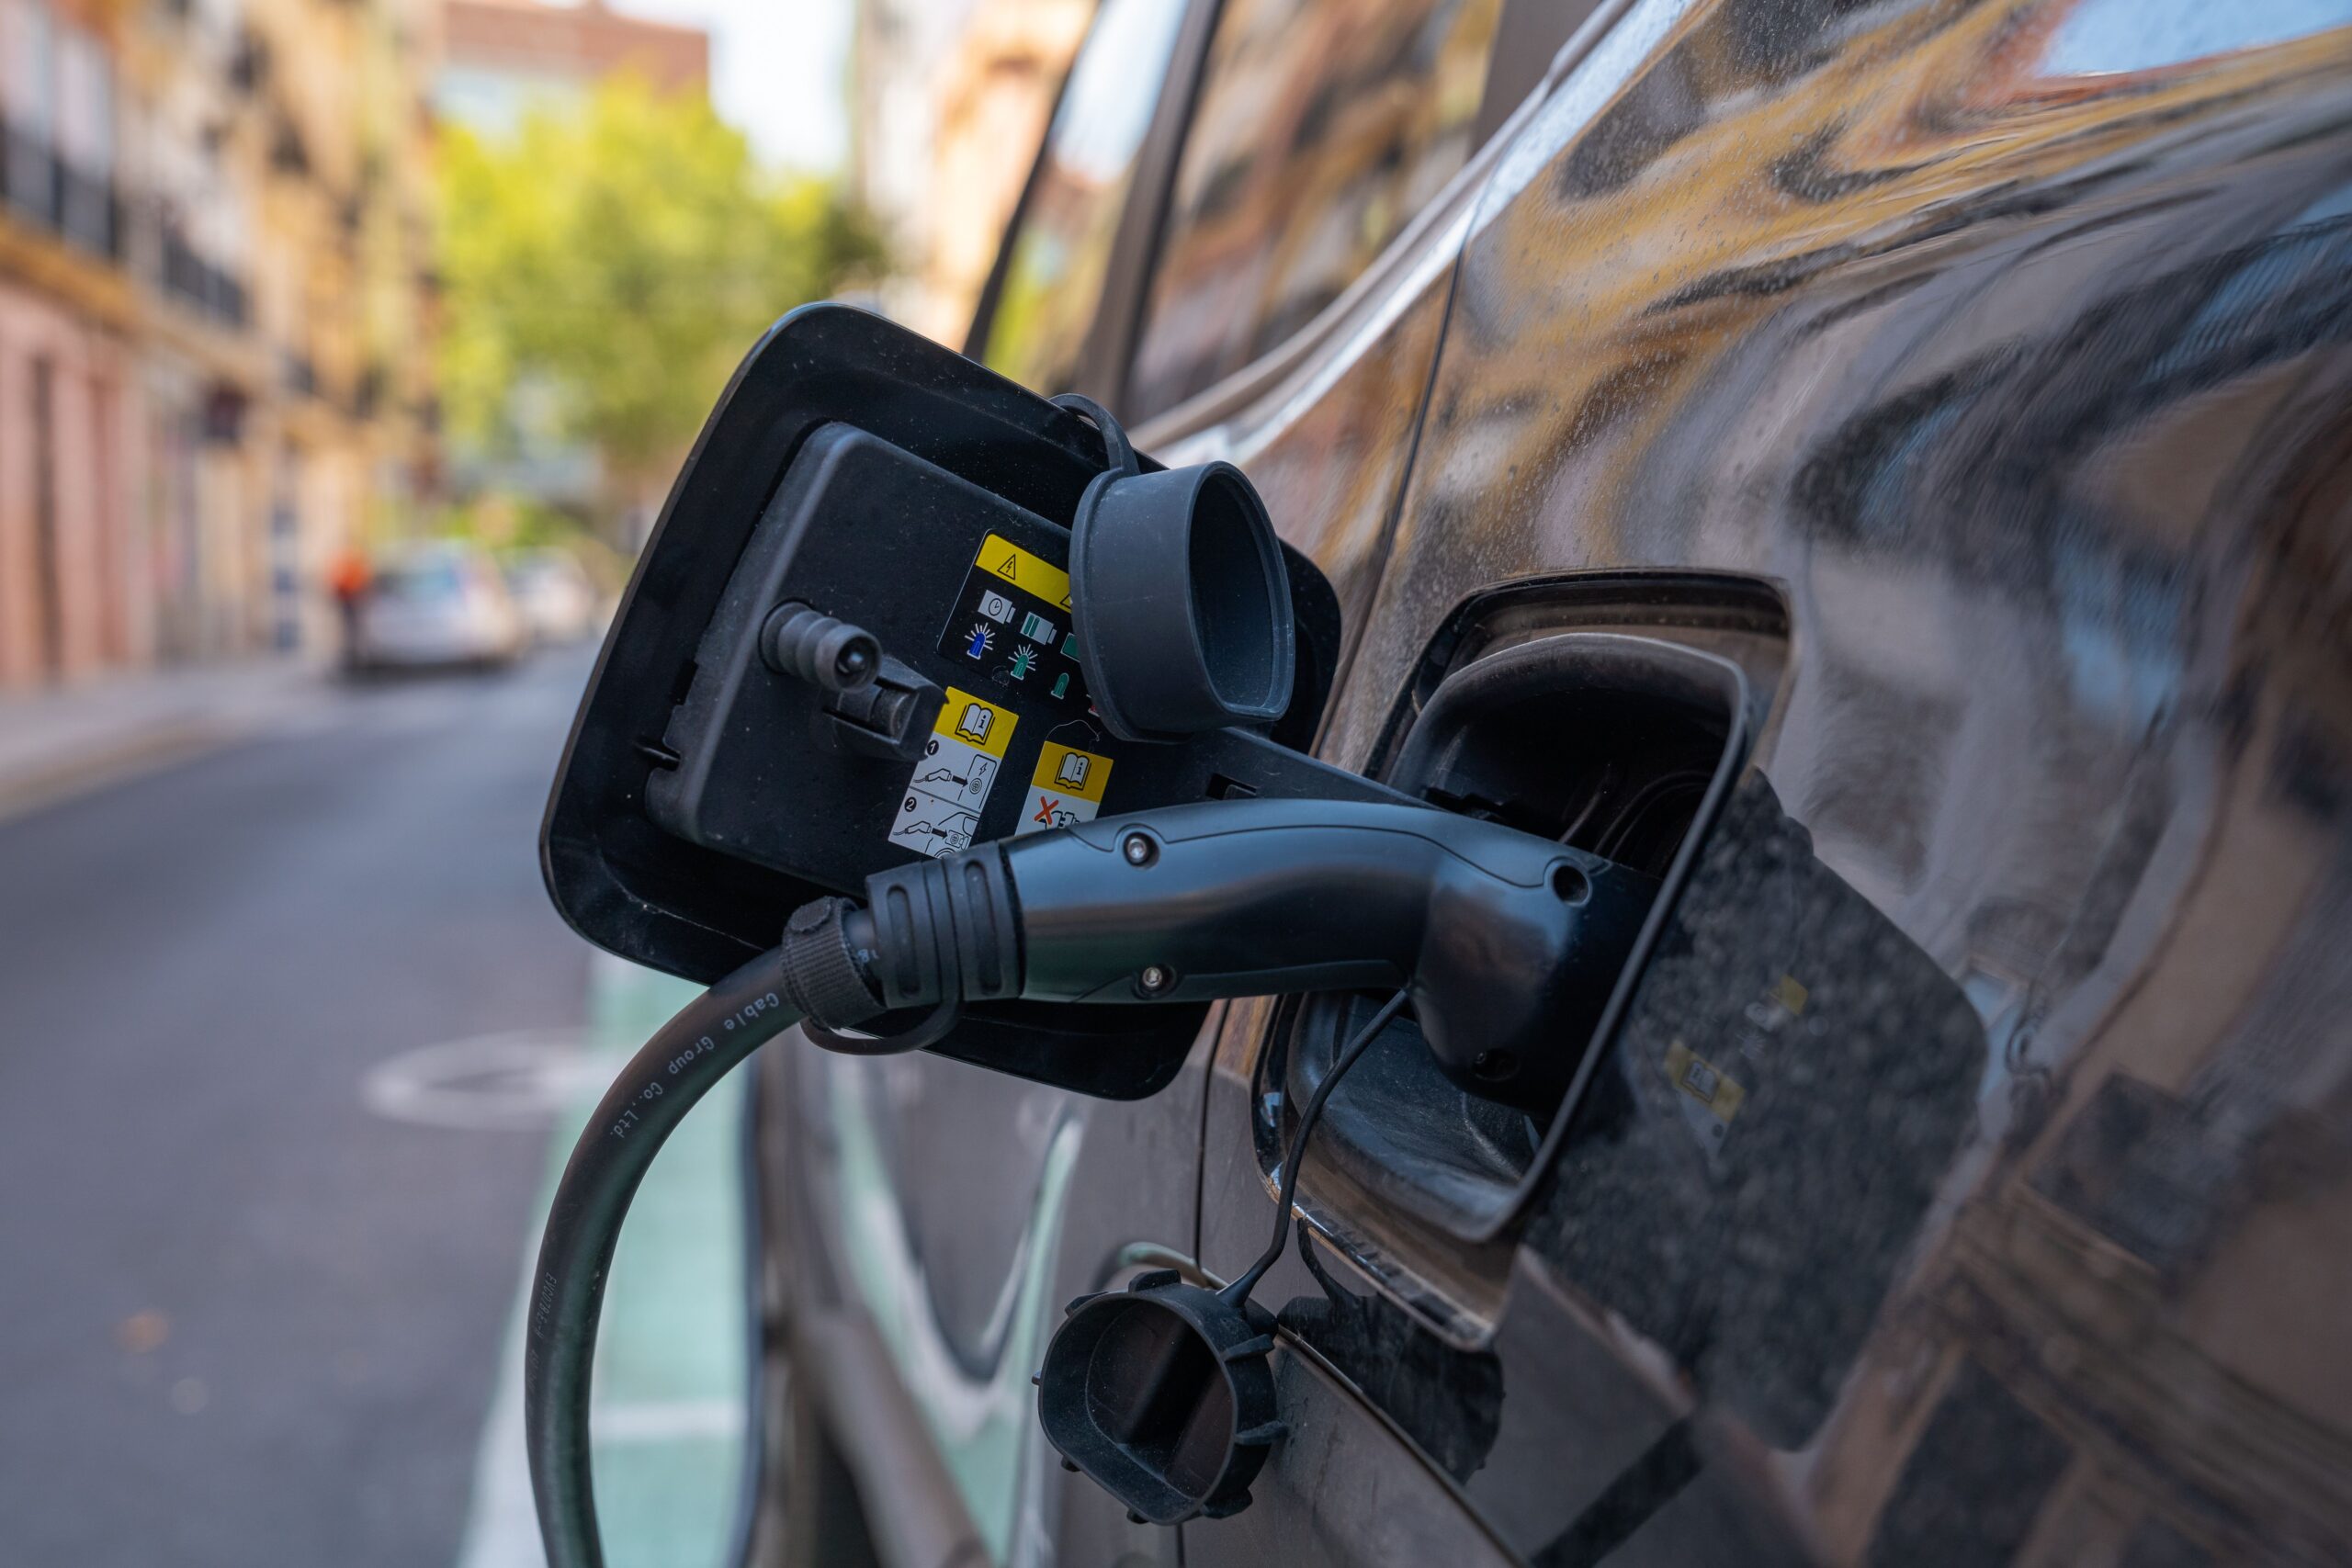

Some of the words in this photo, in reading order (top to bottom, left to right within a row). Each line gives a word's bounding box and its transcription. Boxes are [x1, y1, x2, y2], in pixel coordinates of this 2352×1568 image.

[930, 742, 937, 754] 1
[905, 799, 915, 810] 2
[723, 992, 779, 1031] Cable
[668, 1036, 715, 1075] Group
